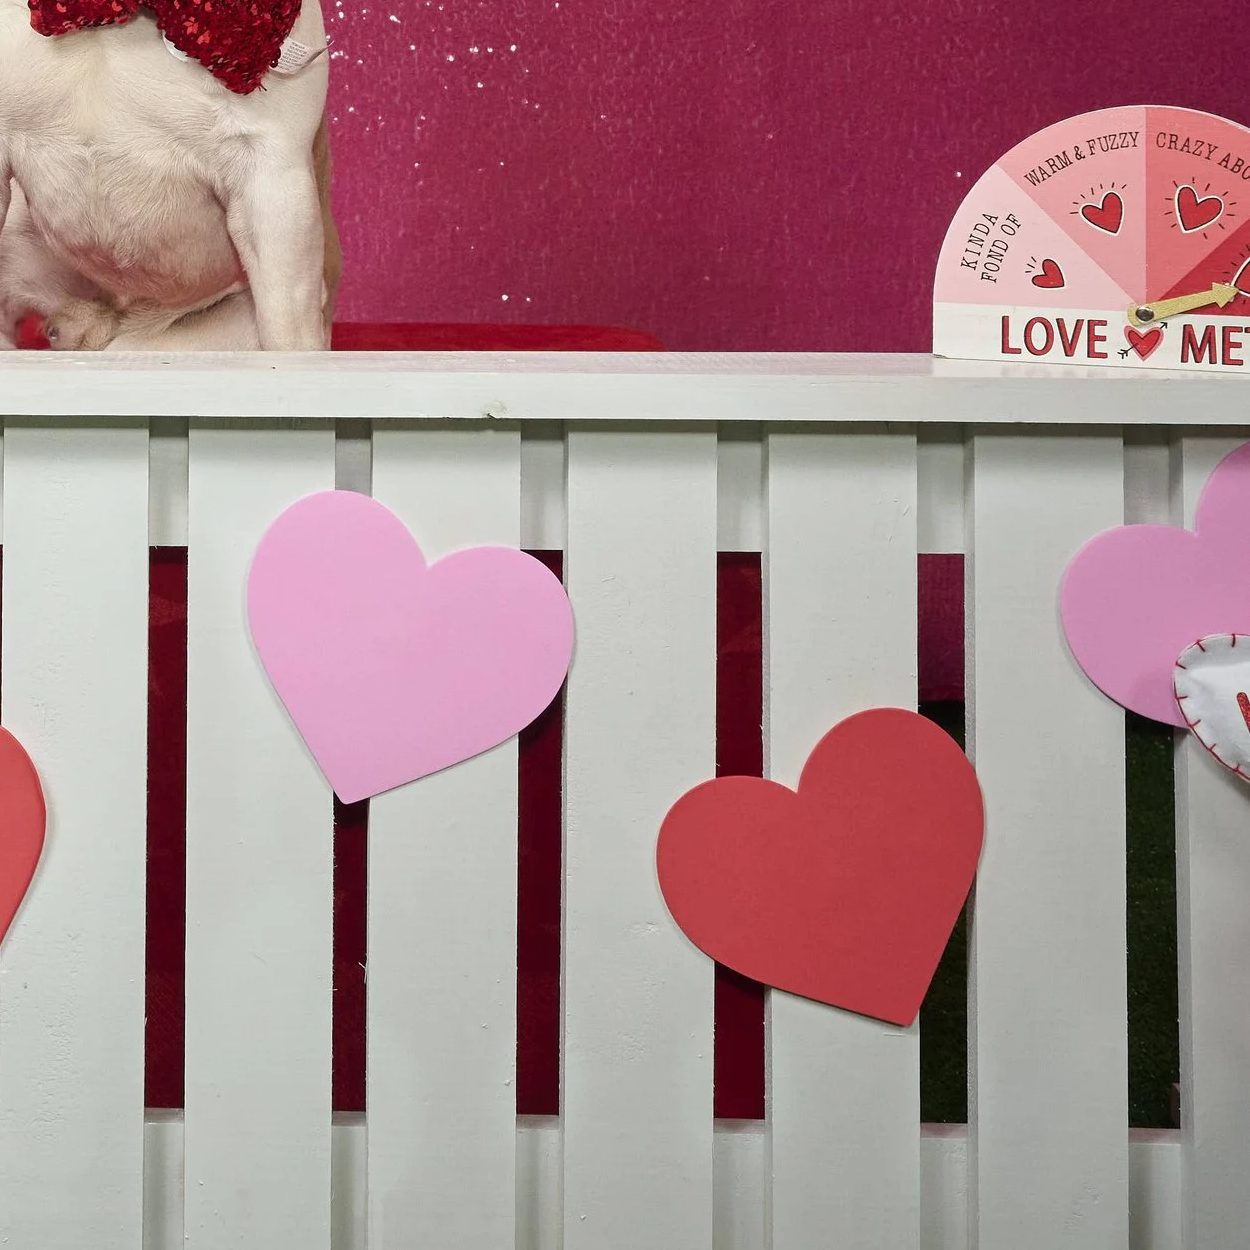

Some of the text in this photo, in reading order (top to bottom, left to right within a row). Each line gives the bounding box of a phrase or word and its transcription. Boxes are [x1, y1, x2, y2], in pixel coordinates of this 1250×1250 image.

[1023, 131, 1140, 187] WARM & FUZZY
[1155, 132, 1219, 161] CRAZY
[960, 213, 999, 271] KINDA
[980, 213, 1022, 284] FOND OF
[1000, 315, 1250, 366] LOVE ME
